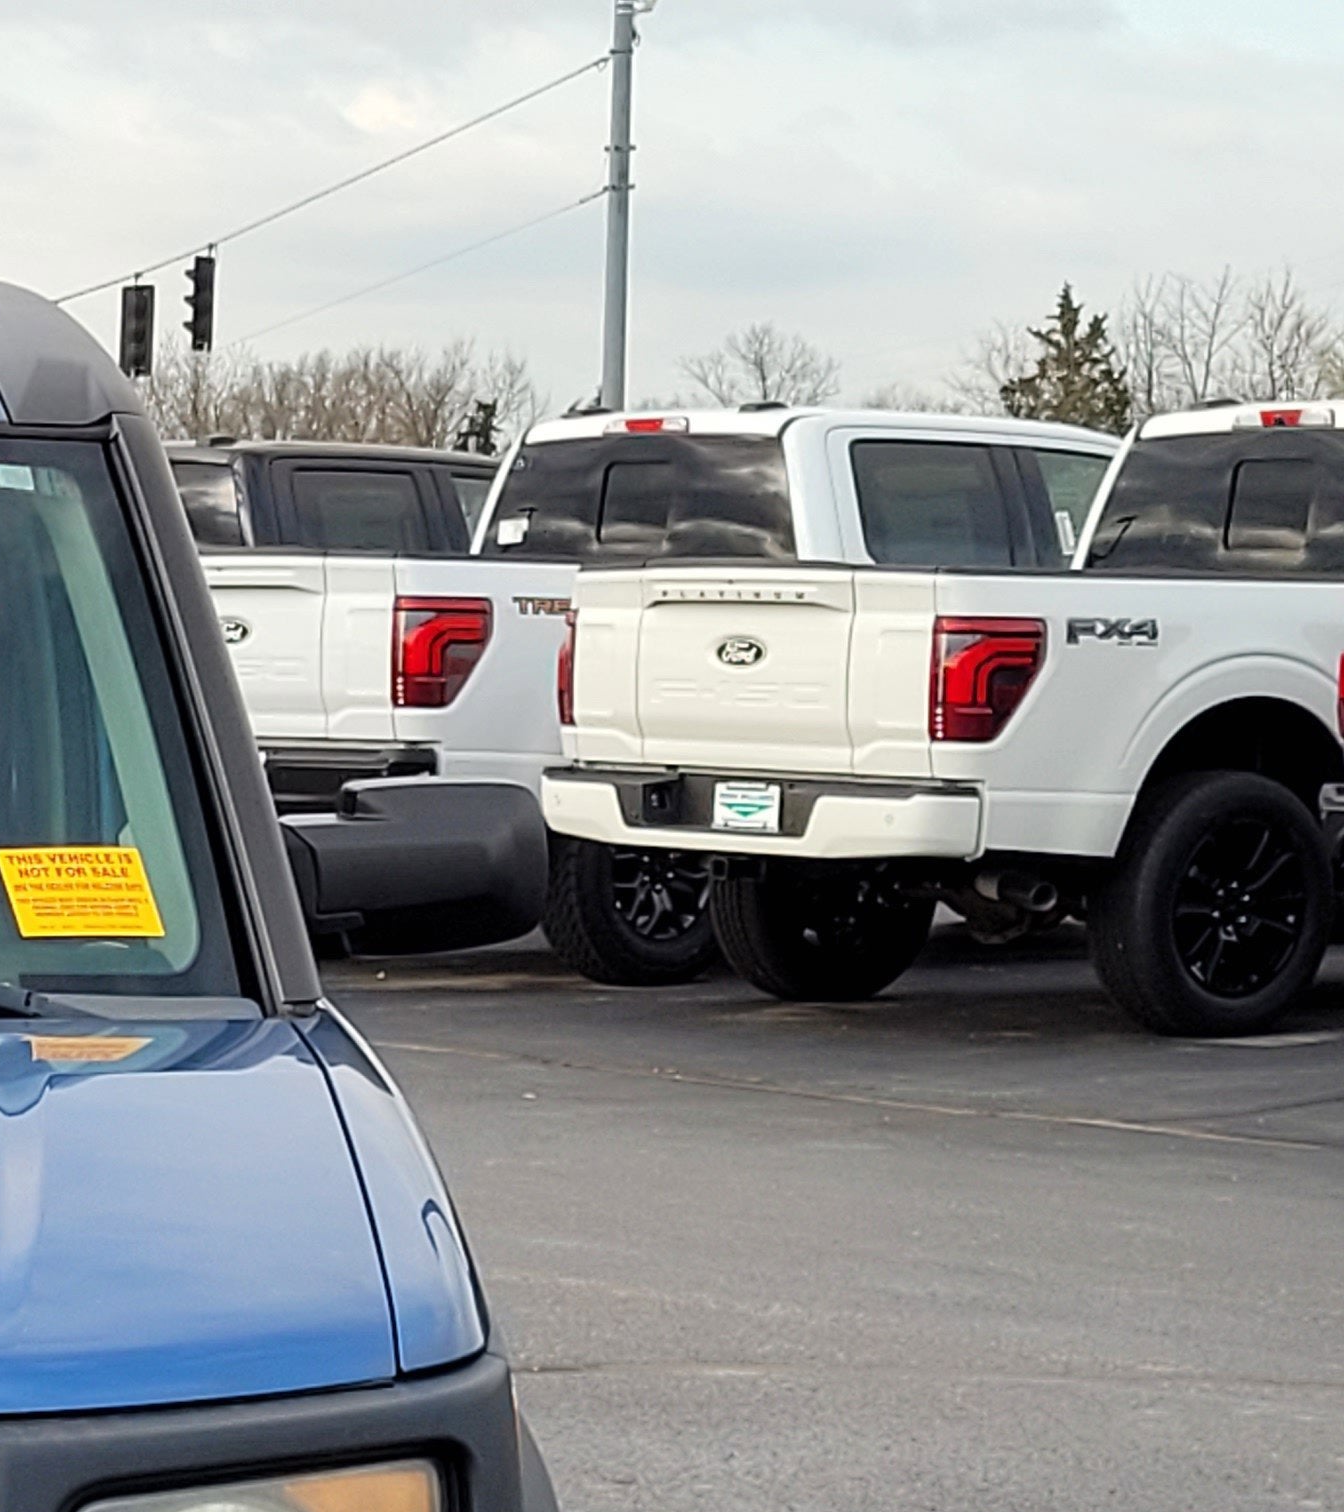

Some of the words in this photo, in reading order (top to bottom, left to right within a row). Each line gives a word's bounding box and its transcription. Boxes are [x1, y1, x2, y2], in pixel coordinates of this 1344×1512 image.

[1066, 617, 1159, 645] FX4
[6, 854, 43, 865] THIS
[46, 853, 115, 864] VEHICLE
[118, 853, 133, 864] IS
[17, 867, 50, 878] NOT
[54, 867, 87, 878] FOR
[91, 867, 130, 878] SALE
